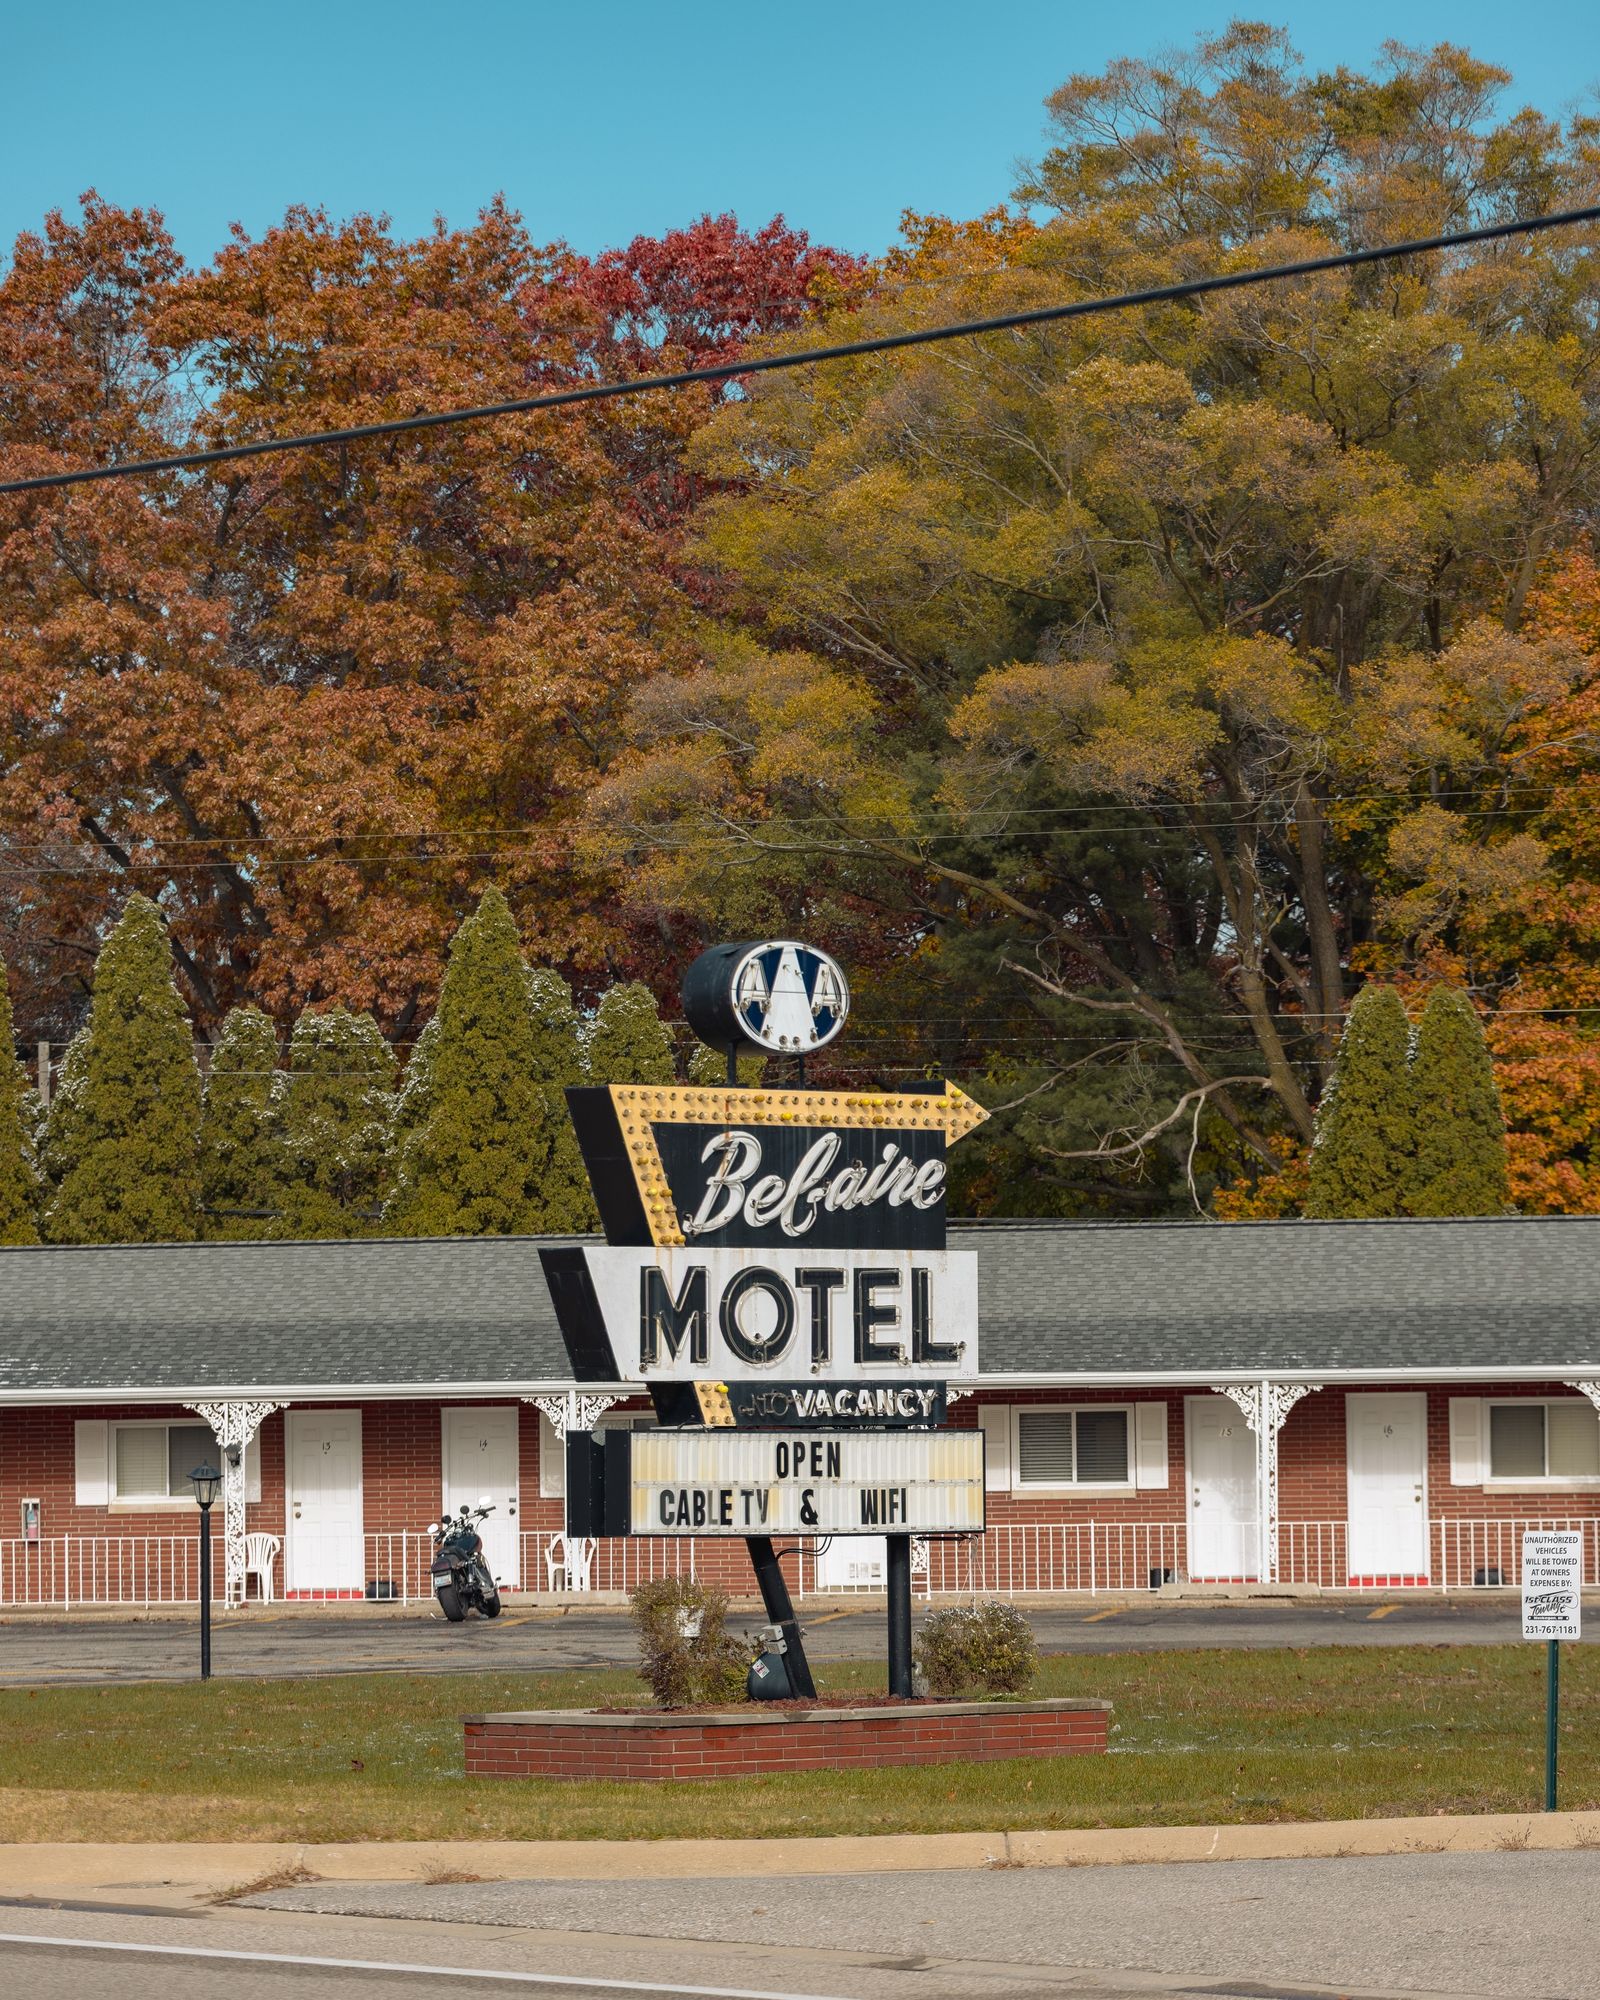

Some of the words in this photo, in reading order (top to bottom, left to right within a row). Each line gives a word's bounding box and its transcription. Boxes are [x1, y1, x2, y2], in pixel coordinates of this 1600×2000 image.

[640, 1265, 963, 1367] MOTEL
[791, 1388, 937, 1418] VACANCY
[776, 1441, 841, 1479] OPEN
[659, 1489, 733, 1526] CABLE
[740, 1488, 769, 1524] TV
[800, 1488, 819, 1525] &
[860, 1487, 907, 1525] WIFI
[1524, 1536, 1579, 1544] UNAUTHORIZED
[1535, 1547, 1568, 1555] VEHICLES
[1525, 1558, 1541, 1566] WILL
[1542, 1558, 1551, 1566] BE
[1552, 1558, 1578, 1566] TOWED
[1531, 1569, 1540, 1577] AT
[1540, 1569, 1571, 1577] OWNERS
[1530, 1579, 1560, 1587] EXPENSE
[1561, 1579, 1573, 1587] BY:
[1540, 1596, 1573, 1604] CLASS
[1525, 1625, 1577, 1634] 231-767-1181
